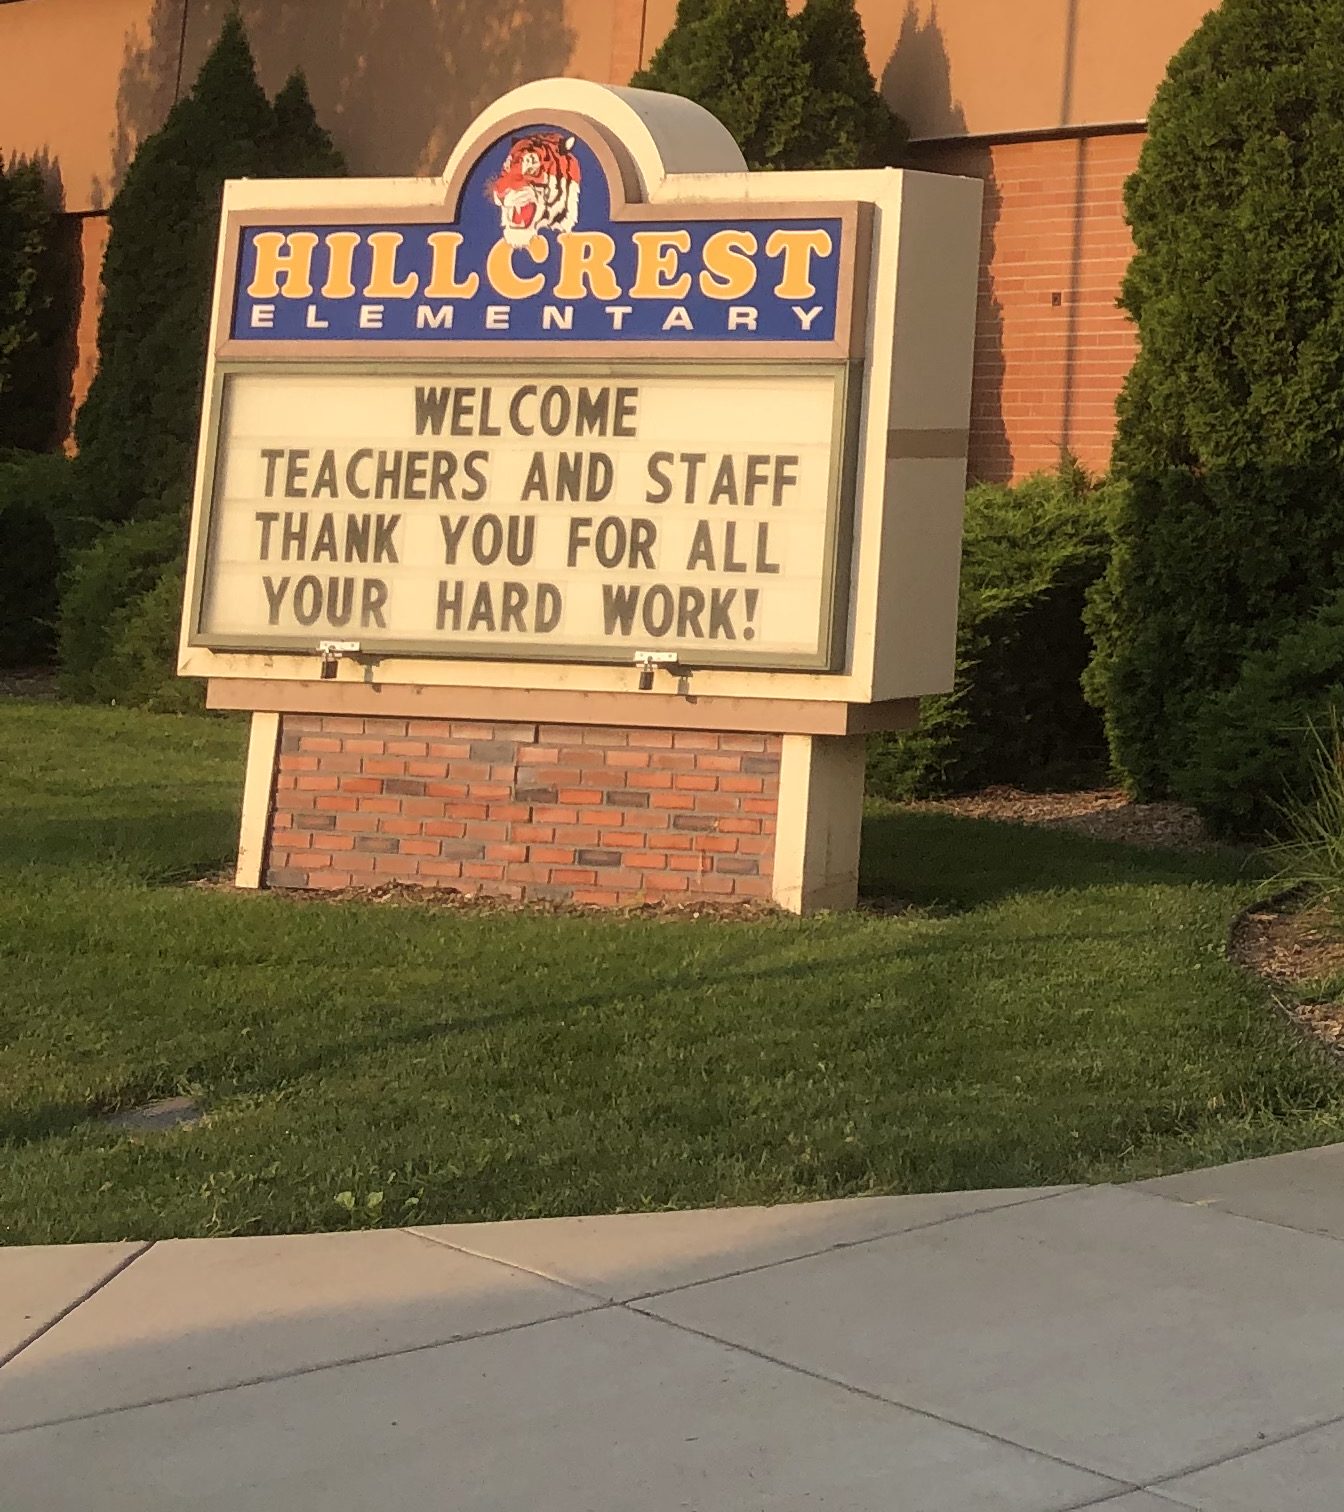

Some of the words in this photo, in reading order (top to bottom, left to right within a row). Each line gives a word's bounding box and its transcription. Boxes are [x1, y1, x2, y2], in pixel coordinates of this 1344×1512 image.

[246, 228, 833, 300] HILLCREST
[249, 304, 824, 330] ELEMENTARY
[414, 384, 639, 437] WELCOME
[260, 448, 489, 501] TEACHERS
[520, 450, 614, 502] AND
[645, 451, 799, 506] STAFF
[255, 511, 401, 563] THANK
[439, 513, 535, 566] YOU
[567, 516, 657, 569] FOR
[686, 519, 780, 574] ALL
[262, 575, 388, 628] YOUR
[436, 580, 562, 633] HARD
[602, 583, 760, 641] WORK!
